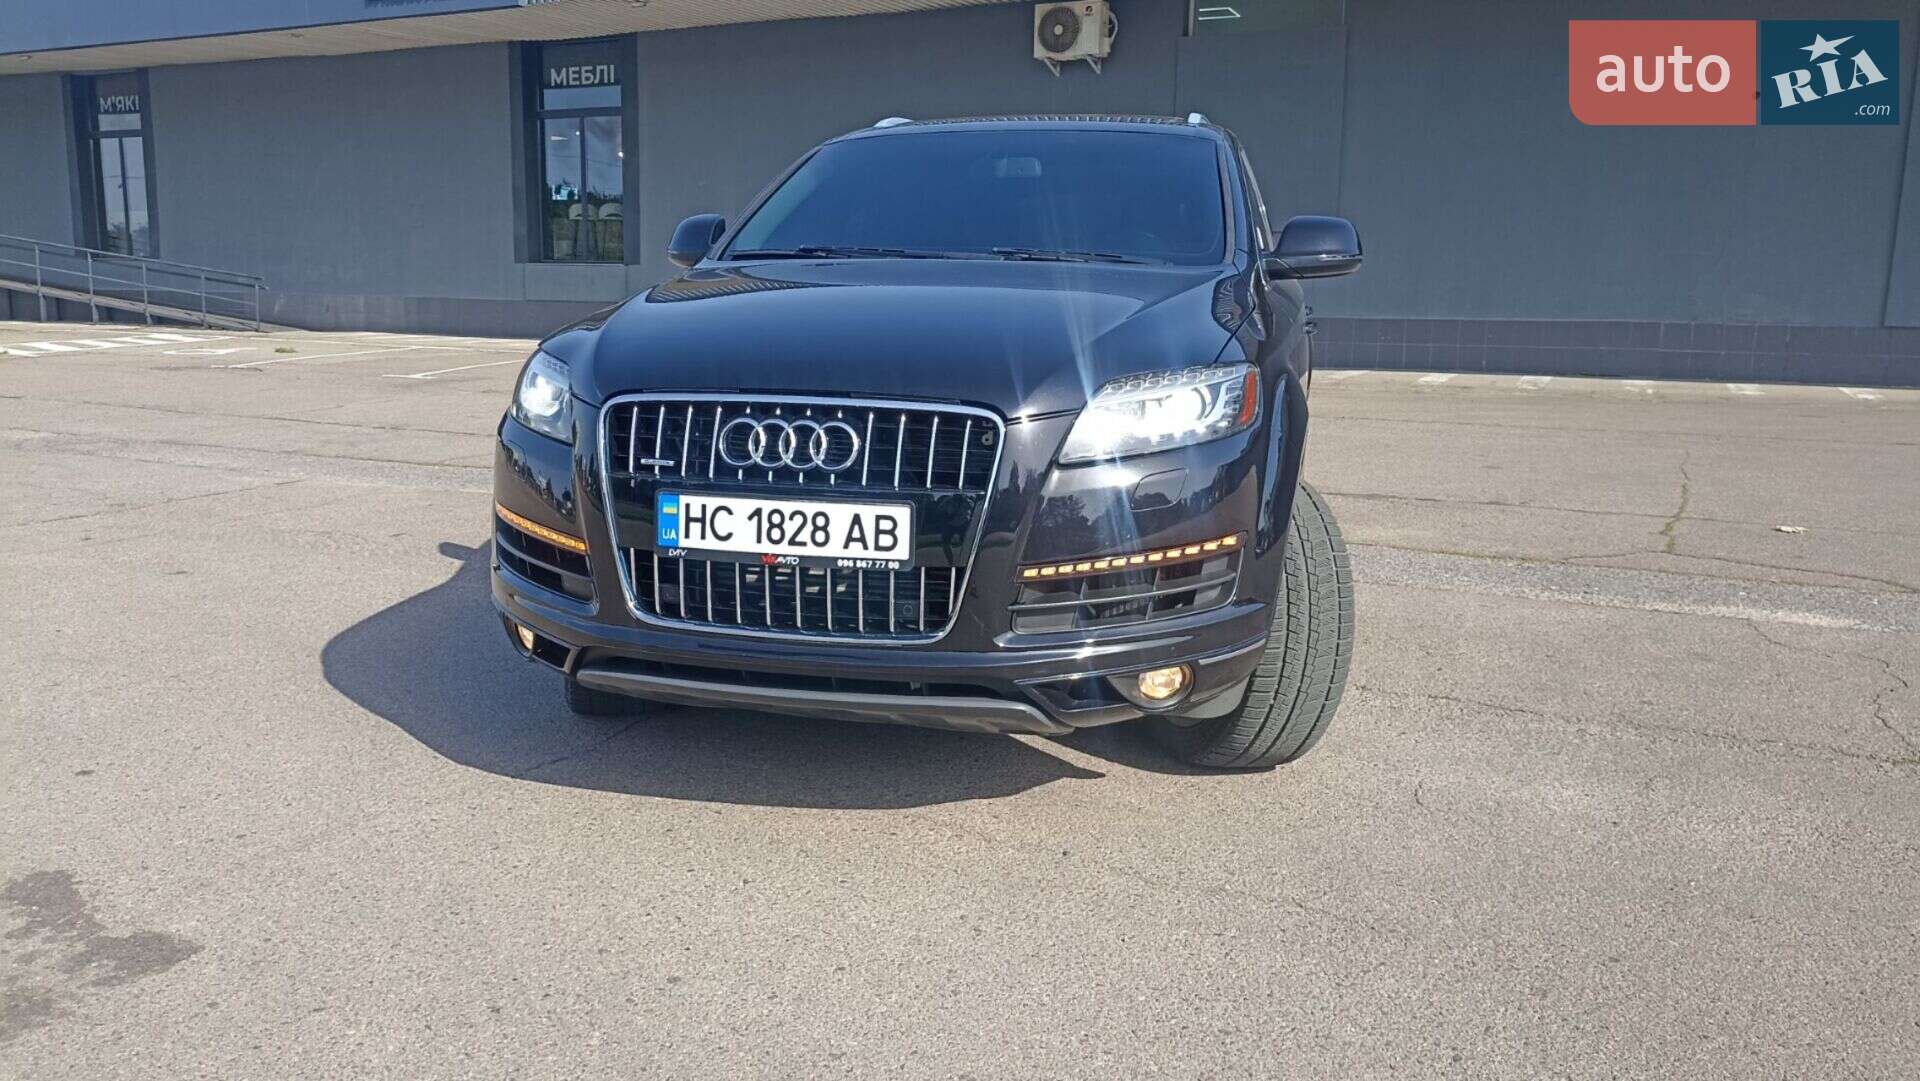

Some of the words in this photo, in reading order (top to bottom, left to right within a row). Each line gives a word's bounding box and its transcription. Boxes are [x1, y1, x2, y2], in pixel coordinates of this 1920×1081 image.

[550, 64, 615, 86] МЕБЛІ
[100, 95, 139, 112] М'ЯКІ
[662, 529, 677, 540] UA
[683, 502, 734, 542] HC
[747, 507, 830, 547] 1828
[842, 513, 899, 552] AB
[875, 560, 886, 568] 77
